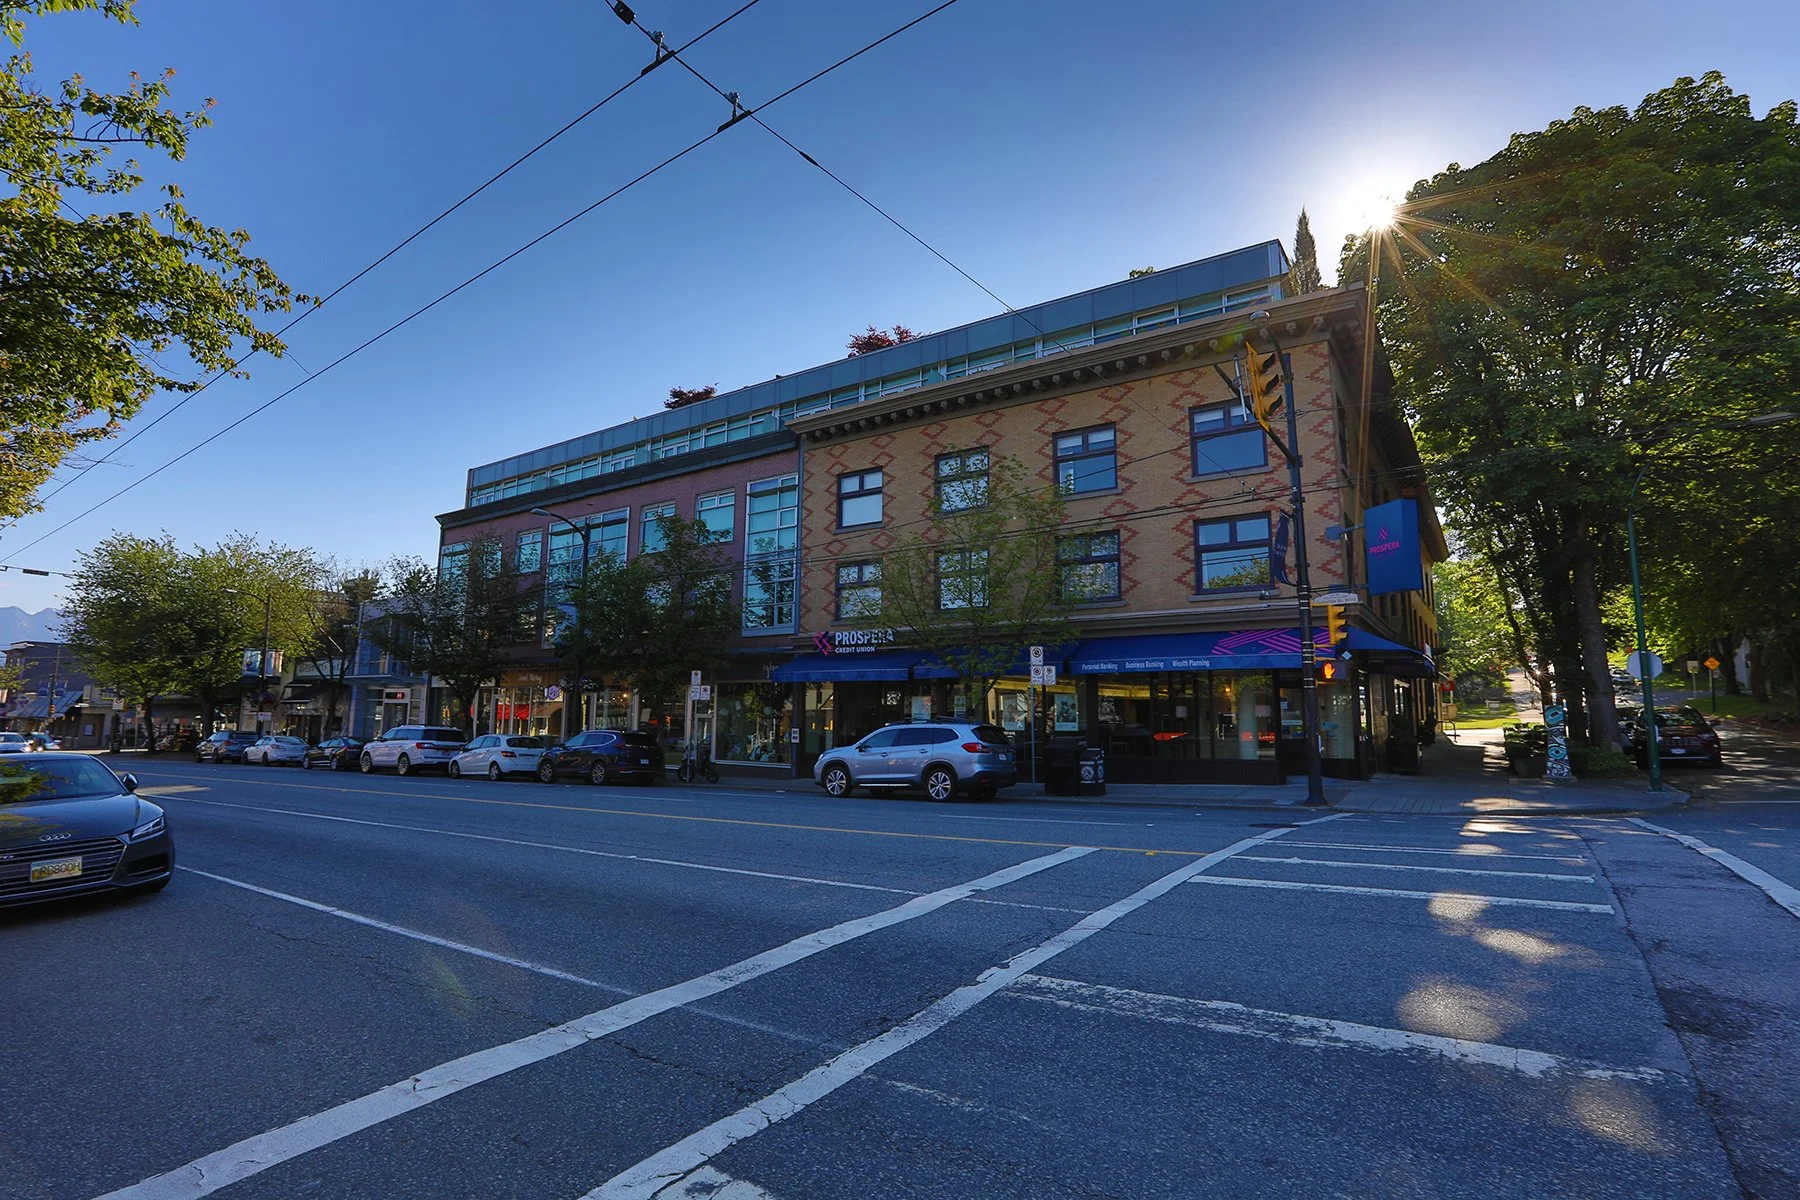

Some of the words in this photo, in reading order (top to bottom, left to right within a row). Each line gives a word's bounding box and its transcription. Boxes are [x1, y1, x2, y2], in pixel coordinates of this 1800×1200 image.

[1369, 540, 1400, 555] PROSPERA
[856, 645, 875, 653] UNION
[1082, 663, 1100, 671] Personal
[1100, 662, 1118, 670] Banking
[1125, 661, 1145, 669] Business
[1146, 660, 1164, 669] Banking
[1172, 659, 1189, 667] Wealth
[1189, 659, 1210, 667] Planning
